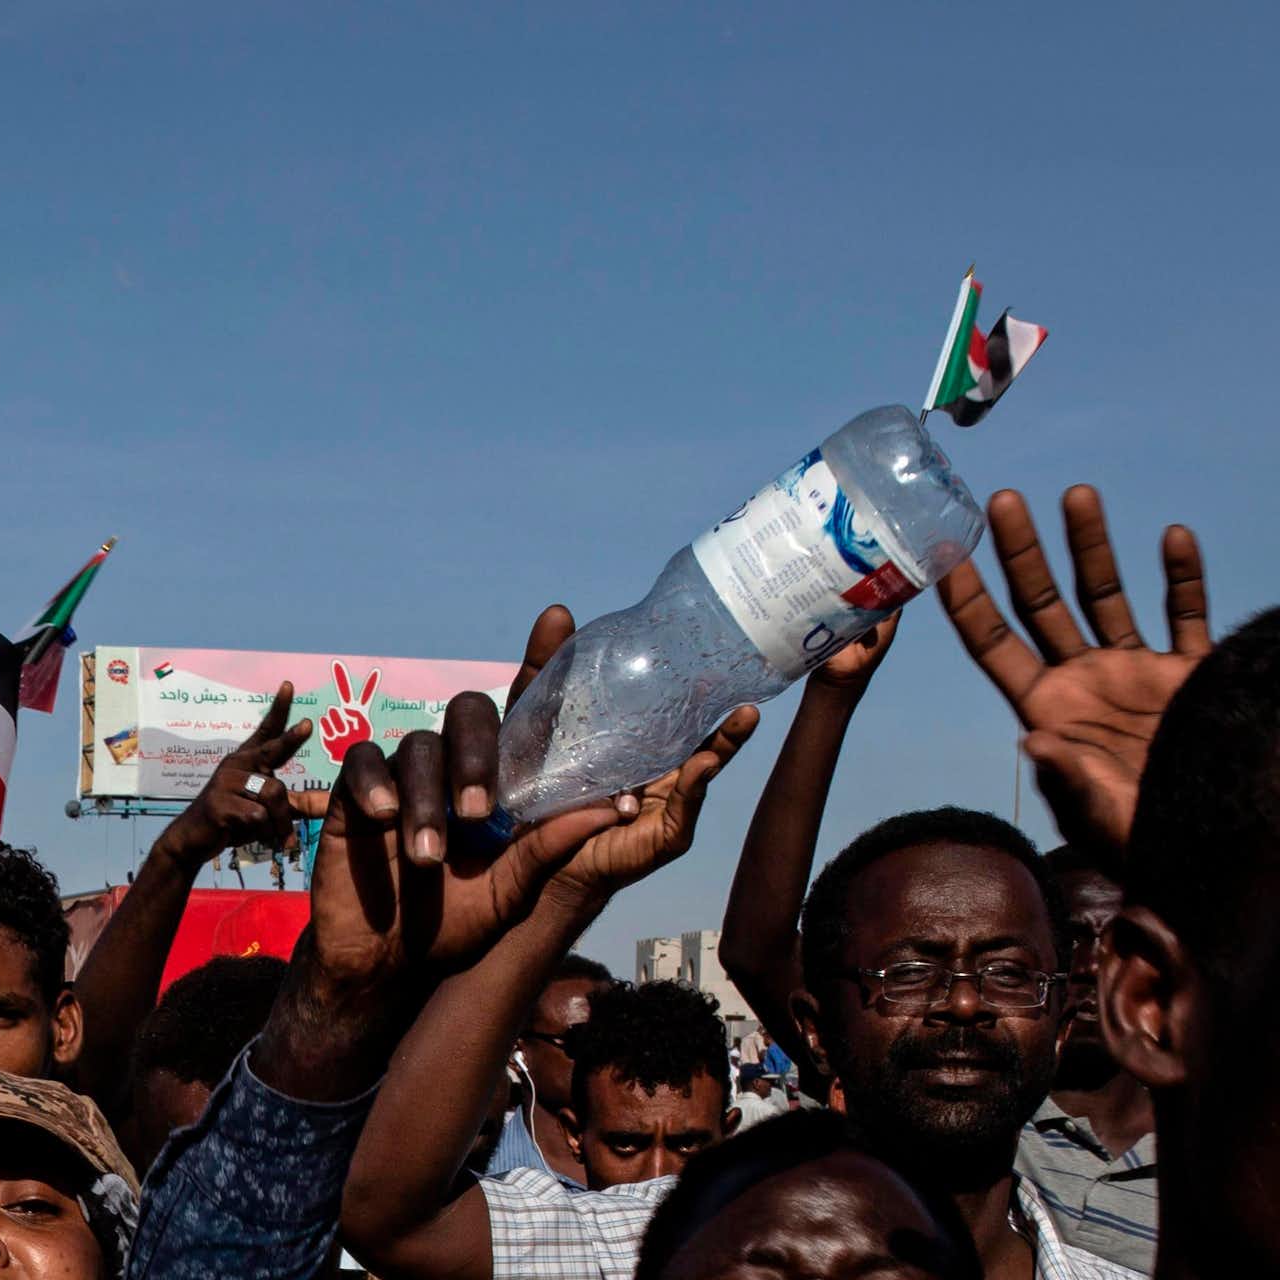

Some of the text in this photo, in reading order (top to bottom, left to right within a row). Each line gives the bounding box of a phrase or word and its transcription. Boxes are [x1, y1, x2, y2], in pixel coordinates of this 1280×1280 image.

[159, 689, 190, 702] واحد
[192, 687, 228, 704] جيش
[380, 698, 426, 711] المشوار
